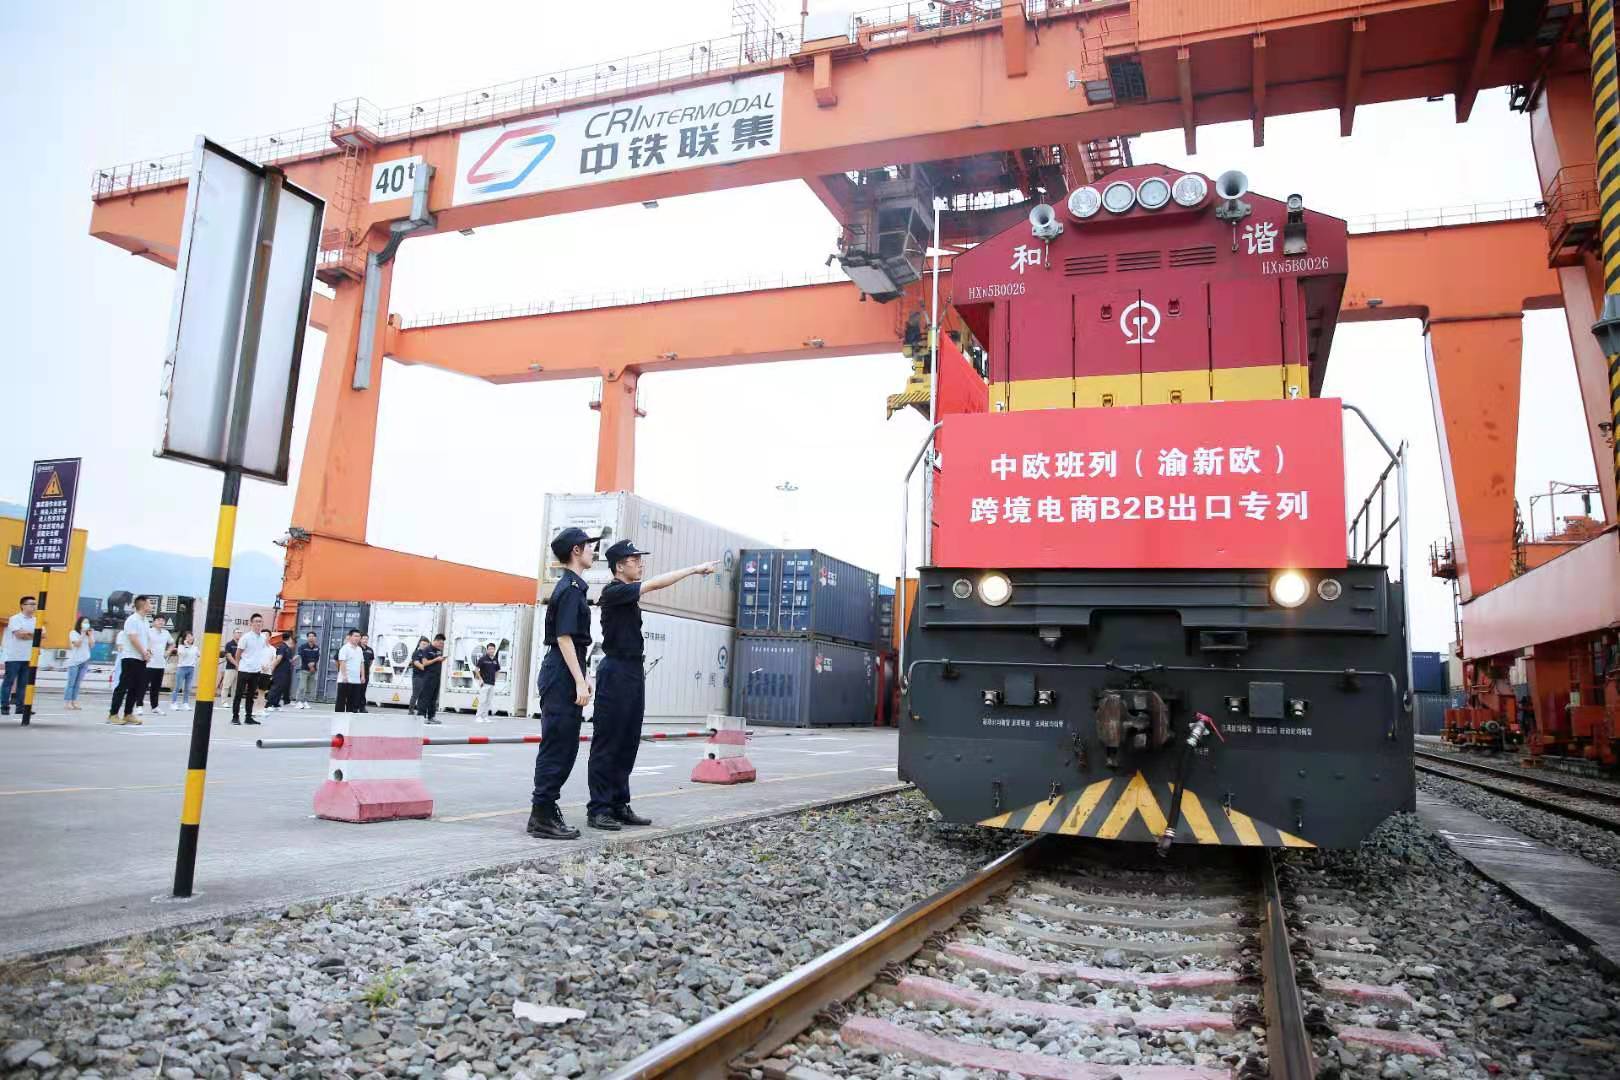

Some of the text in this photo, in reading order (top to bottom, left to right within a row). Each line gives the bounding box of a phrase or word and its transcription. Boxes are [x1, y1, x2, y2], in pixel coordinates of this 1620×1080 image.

[579, 114, 775, 175] 中铁联集
[1242, 221, 1279, 255] 谐
[1010, 243, 1041, 275] 和
[970, 489, 1309, 526] 跨境电商B2B出口专列
